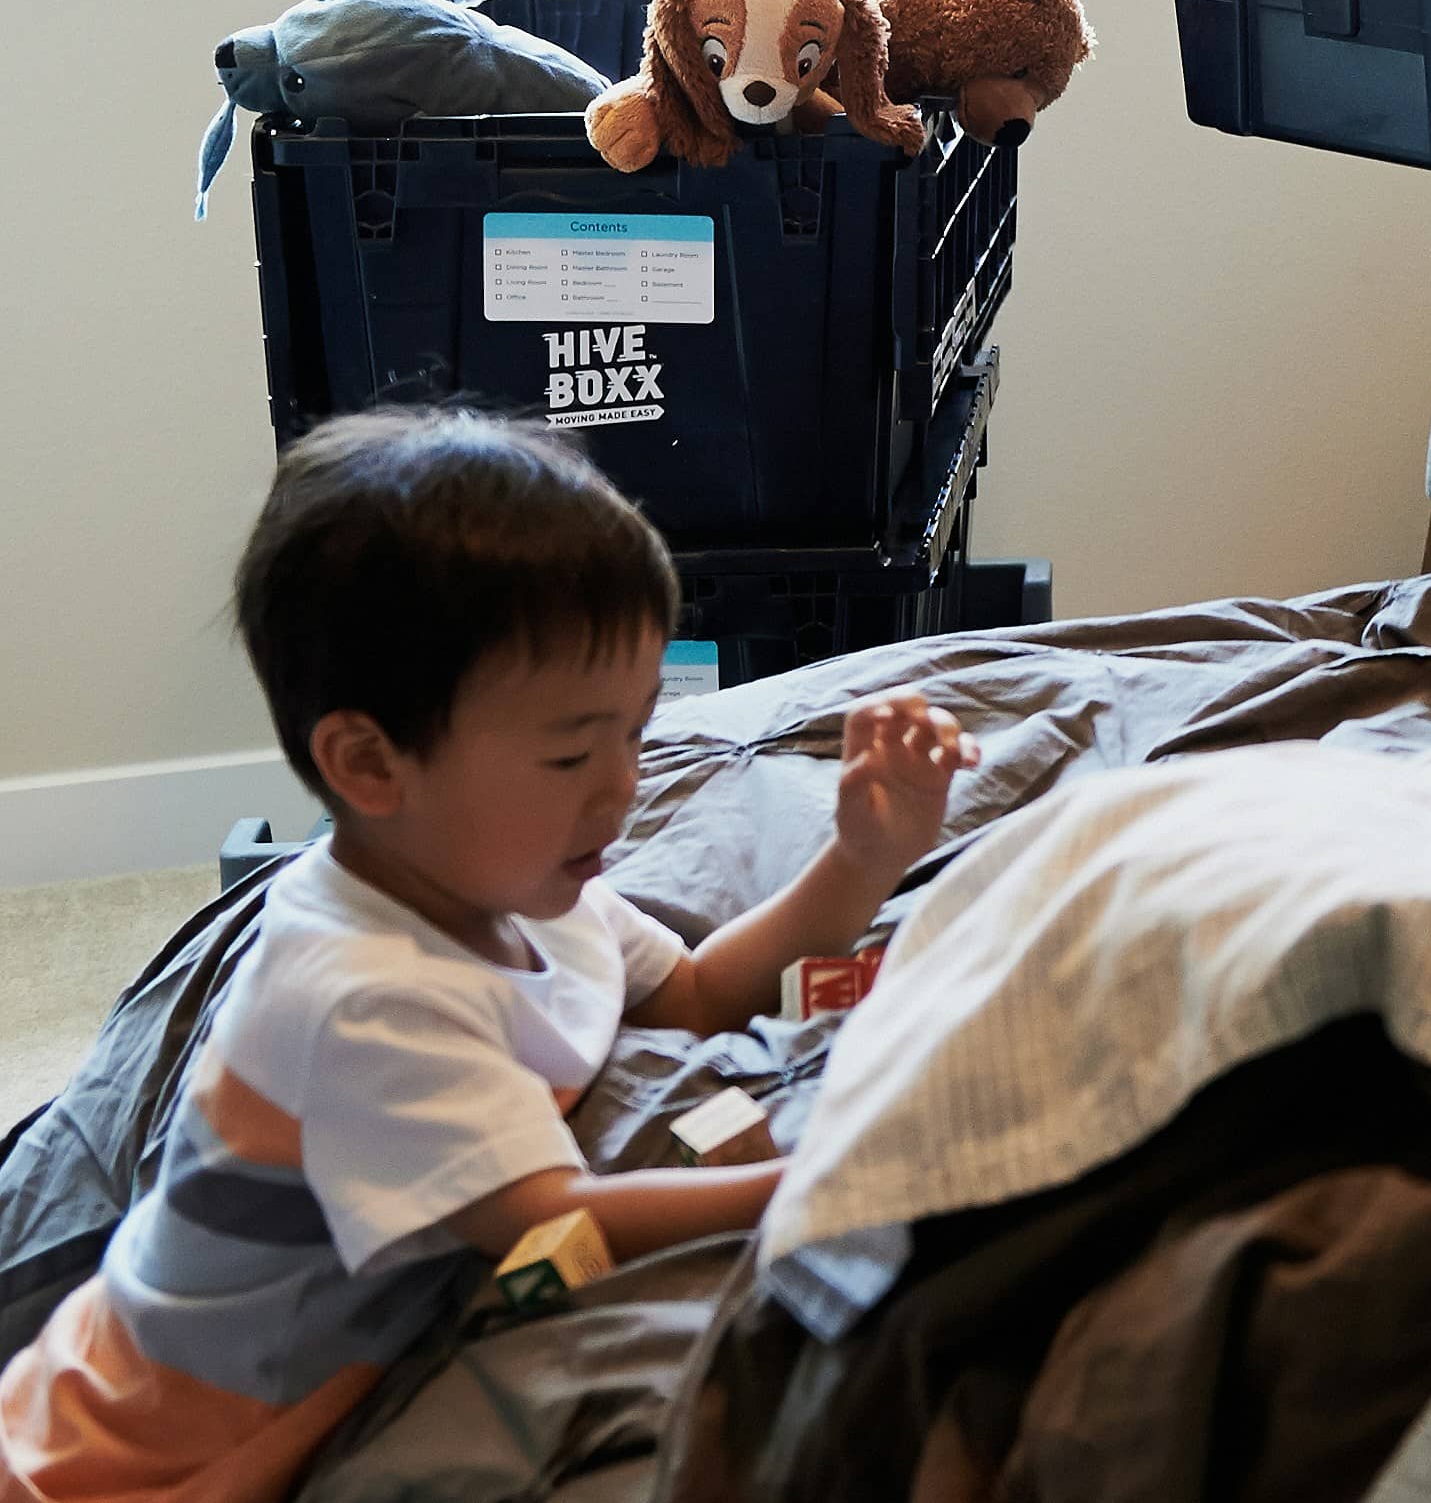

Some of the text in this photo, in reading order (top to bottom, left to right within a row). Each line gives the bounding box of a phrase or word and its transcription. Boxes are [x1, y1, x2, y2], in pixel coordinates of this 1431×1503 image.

[570, 221, 628, 233] Contents
[542, 325, 646, 368] HIVE
[544, 364, 665, 409] BOXX
[555, 408, 656, 426] MOVING MADE EASY
